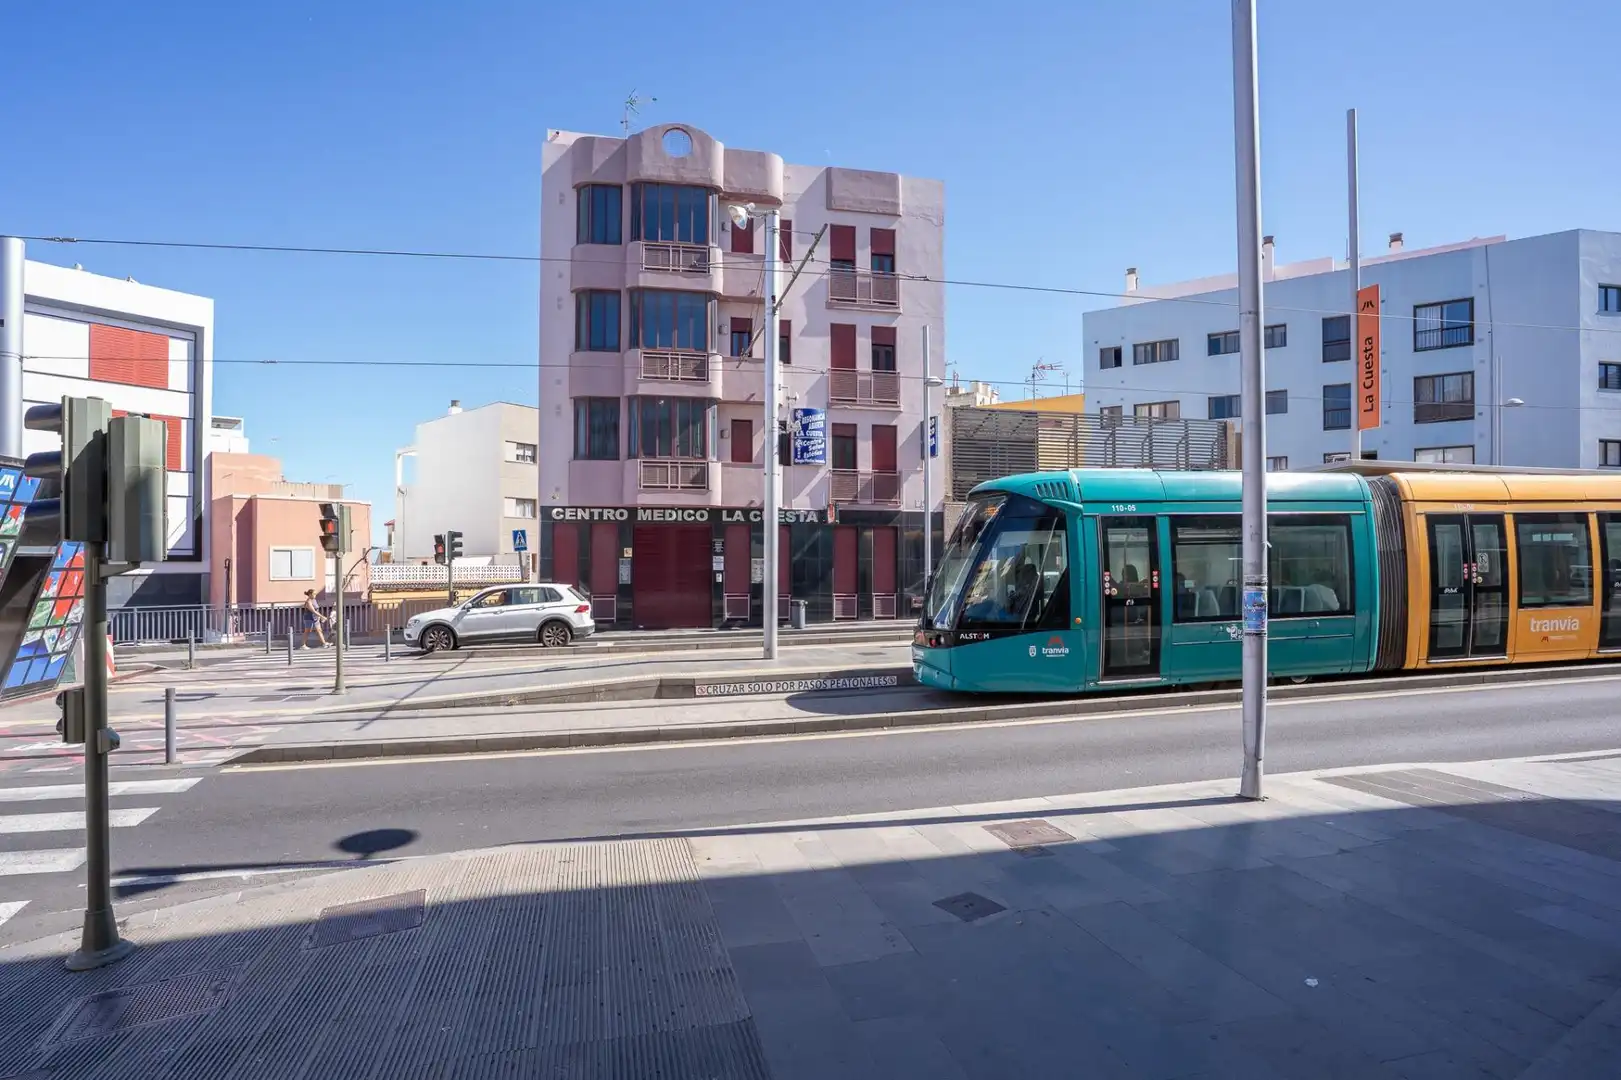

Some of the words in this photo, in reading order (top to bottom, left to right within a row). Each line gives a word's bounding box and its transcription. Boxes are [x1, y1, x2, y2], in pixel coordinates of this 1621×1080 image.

[1363, 336, 1374, 389] Cuesta
[1363, 395, 1374, 413] La
[551, 507, 629, 520] CENTRO
[637, 508, 709, 521] MEDICO
[722, 510, 745, 521] LA
[750, 510, 819, 523] CESTA
[1111, 504, 1137, 512] 110-05
[1530, 615, 1580, 632] tranvía
[959, 632, 990, 640] ALSTOM
[706, 684, 745, 696] CRUZAR
[747, 682, 773, 692] SOLO
[776, 681, 795, 692] POR
[798, 679, 828, 691] PASOS
[830, 677, 888, 690] PEATONALES
